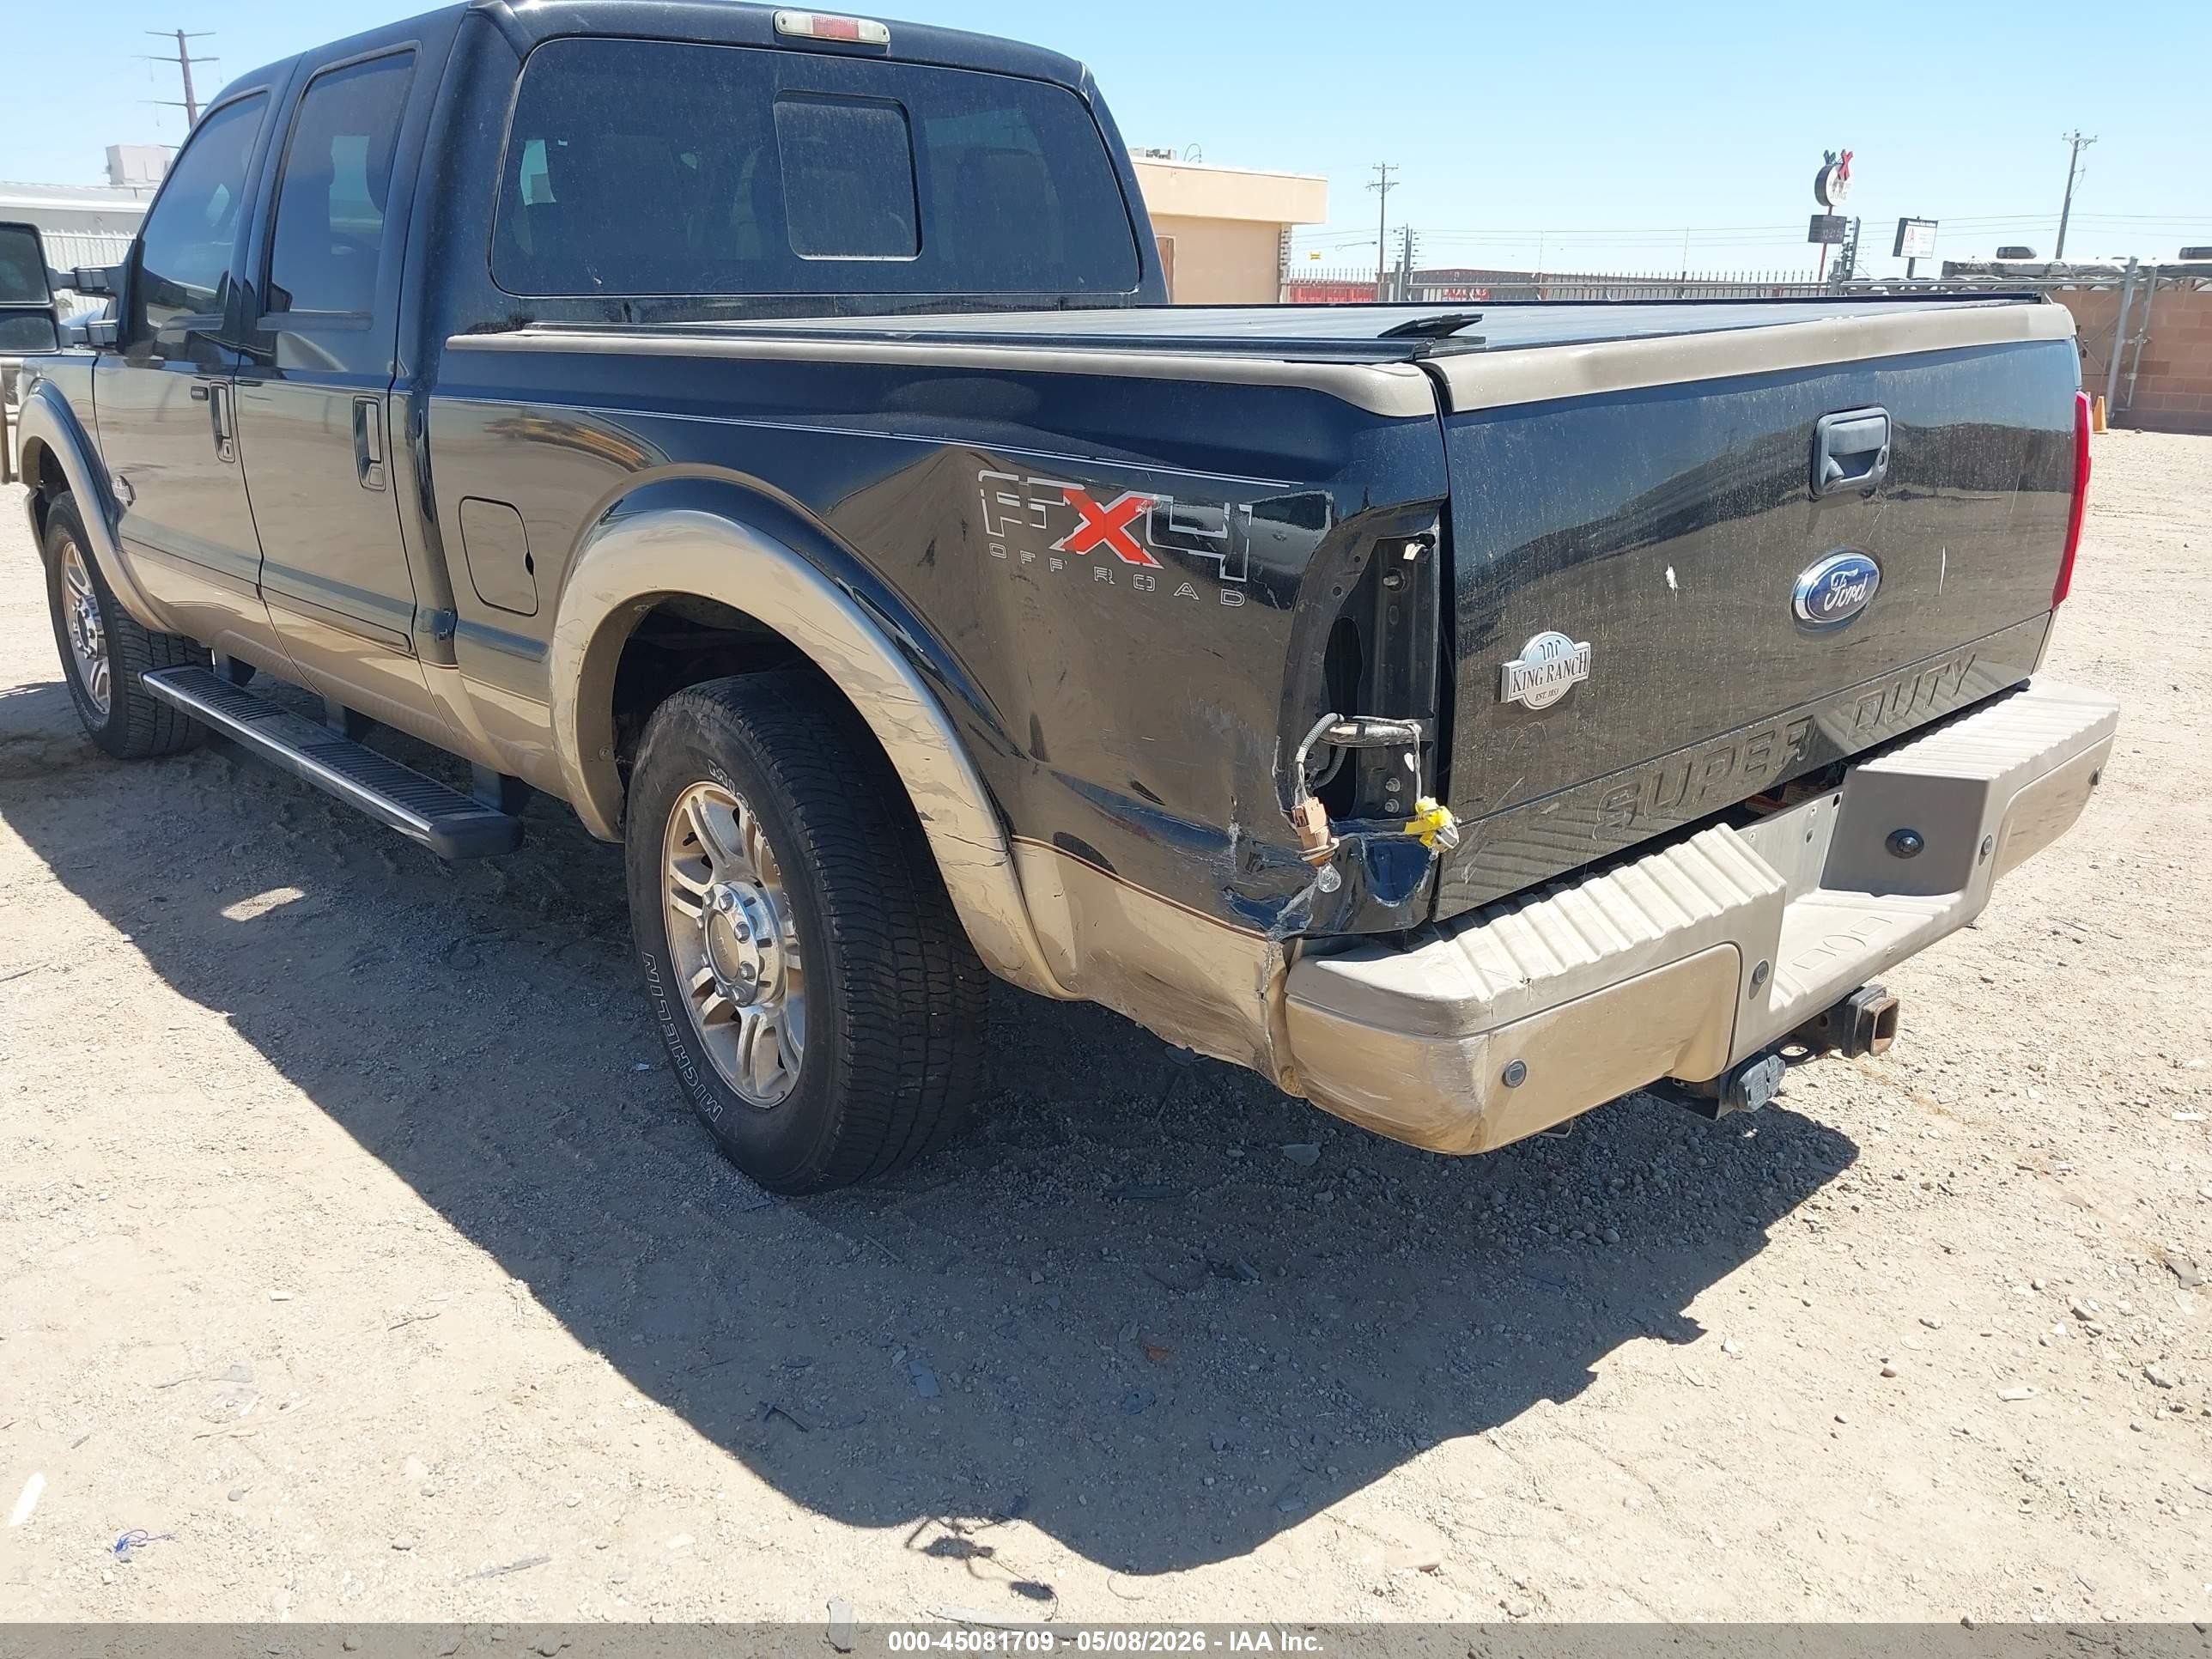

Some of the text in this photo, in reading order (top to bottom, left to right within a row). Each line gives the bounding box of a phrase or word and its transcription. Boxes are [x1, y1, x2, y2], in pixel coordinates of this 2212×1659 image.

[978, 469, 1253, 582] FX4
[988, 541, 1245, 608] OFF ROAD
[1823, 567, 1869, 612] Ford
[1512, 650, 1588, 693] KING RANCH
[1534, 690, 1547, 702] EST.
[1595, 653, 1978, 835] SUPER DUTY
[641, 951, 724, 1123] MICHELIN
